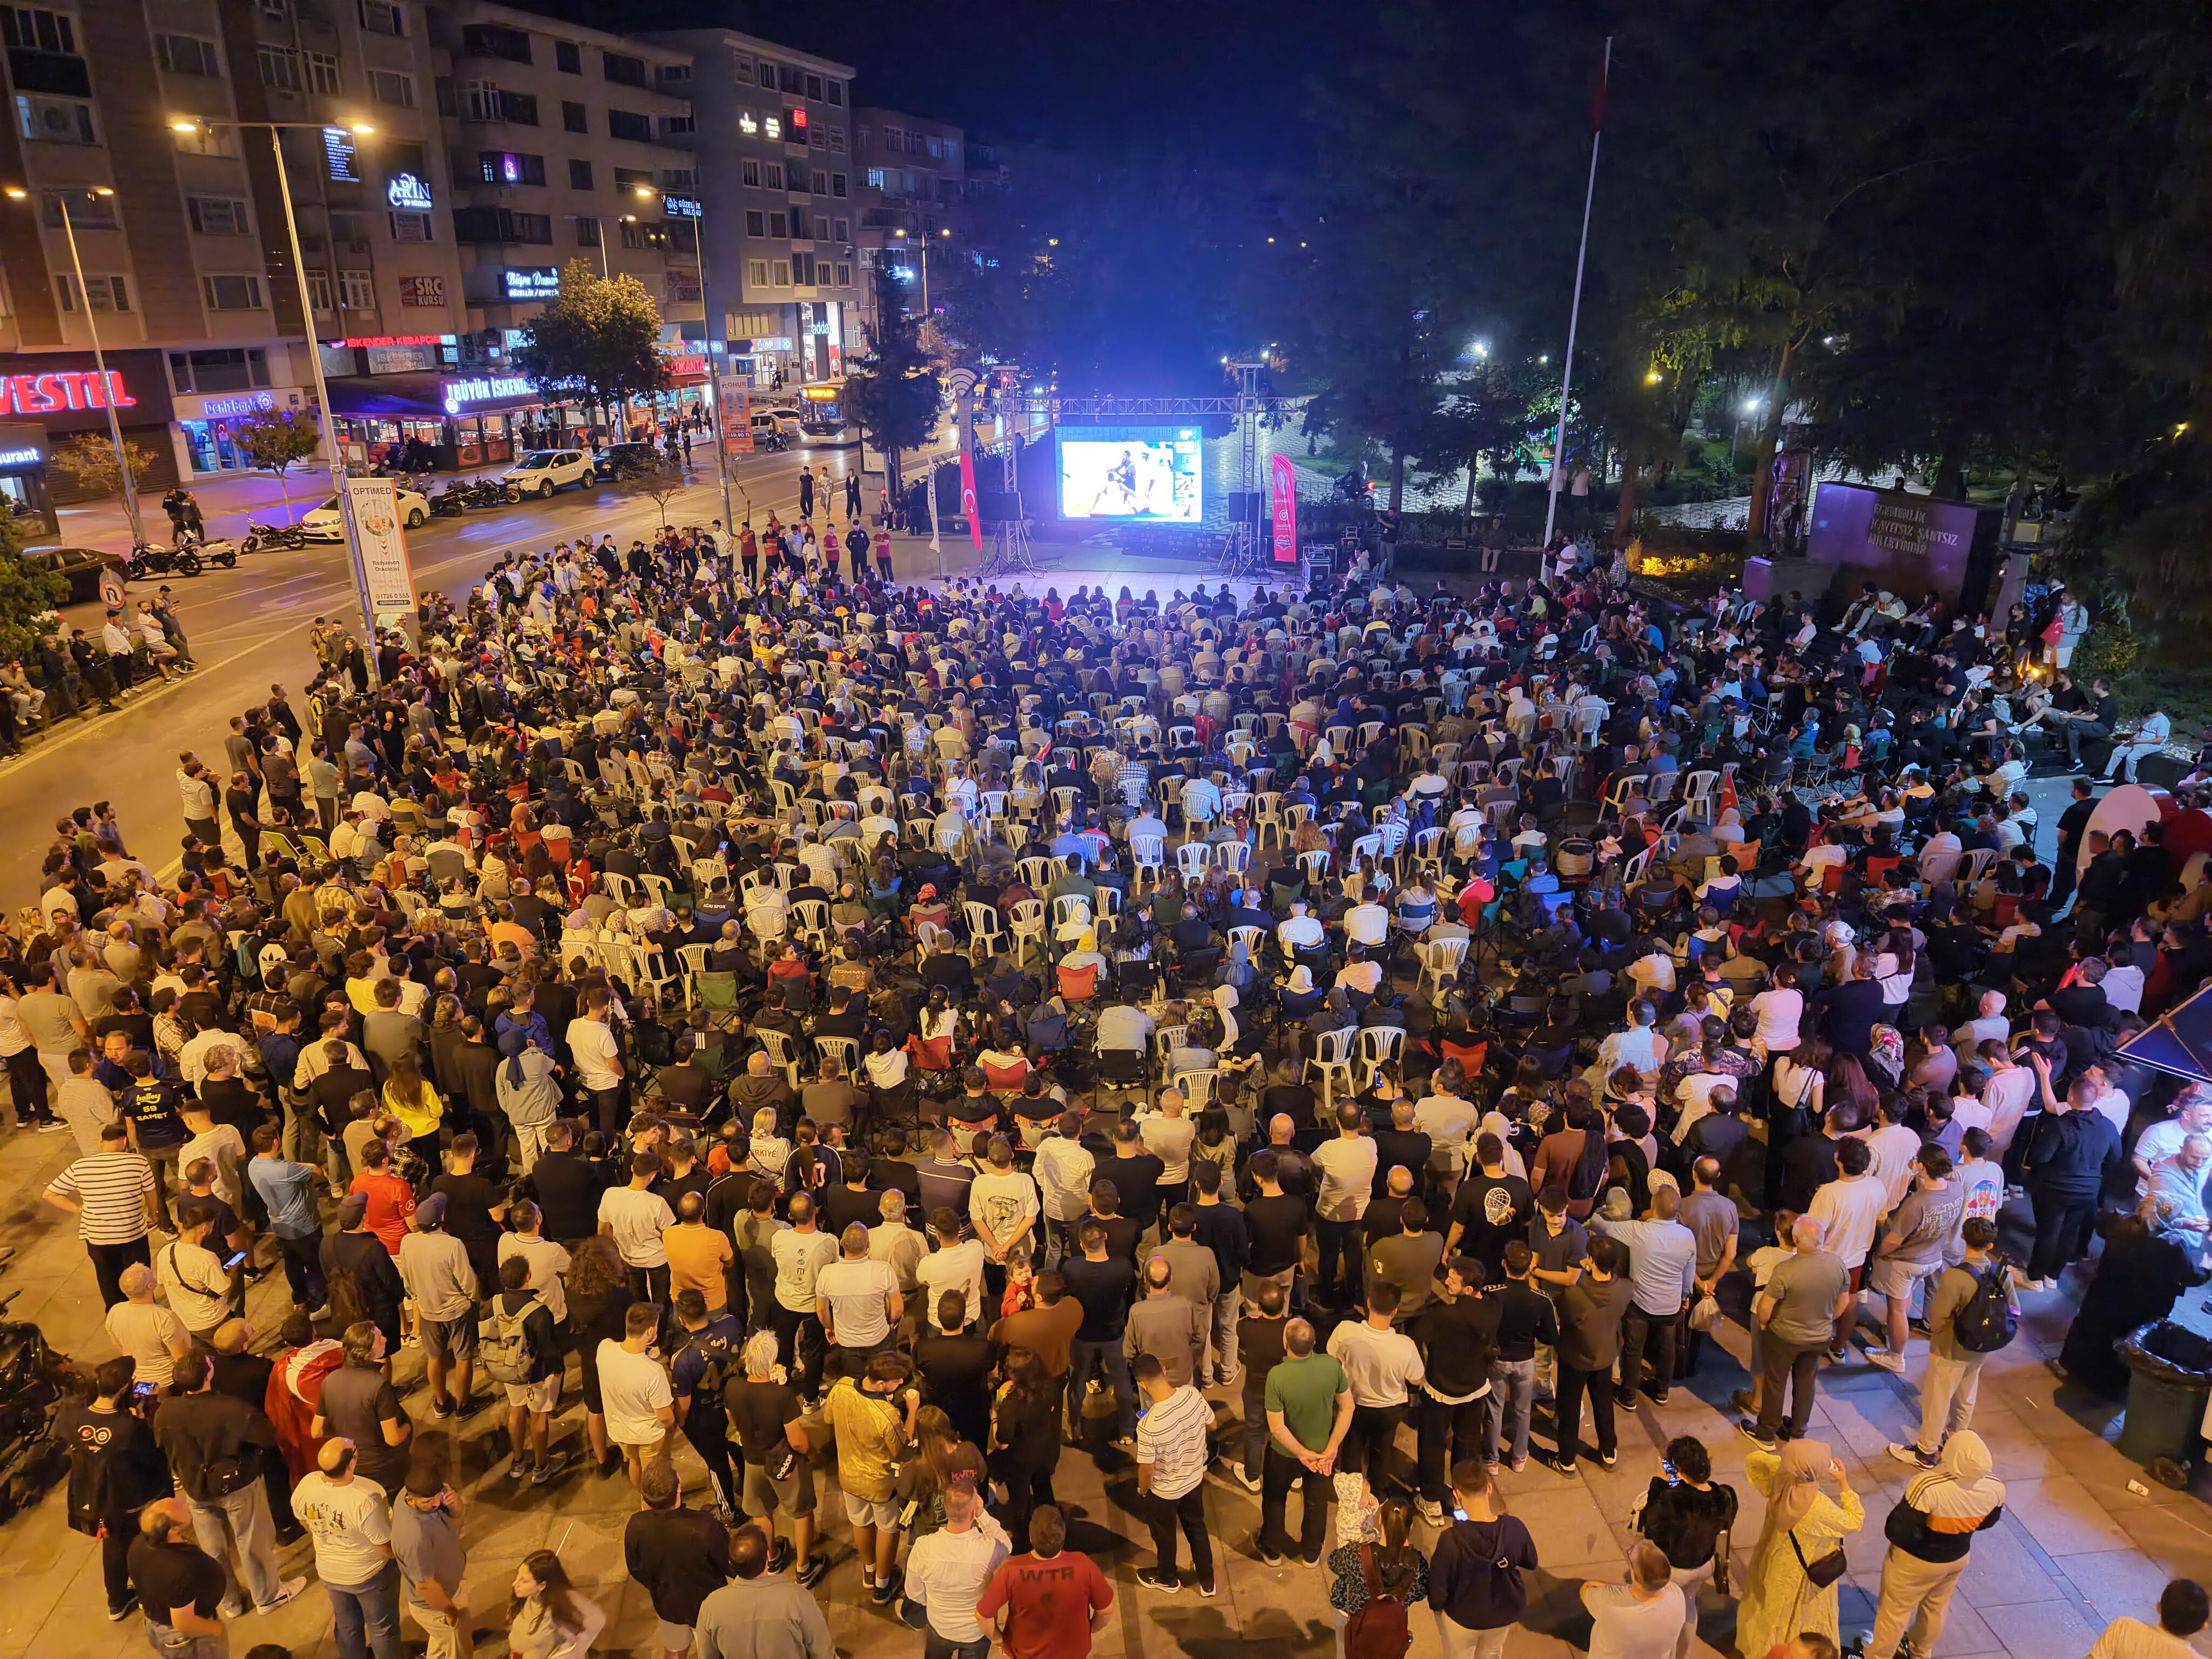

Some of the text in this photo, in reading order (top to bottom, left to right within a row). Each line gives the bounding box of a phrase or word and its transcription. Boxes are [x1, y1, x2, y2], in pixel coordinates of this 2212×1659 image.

[415, 277, 442, 295] SRC
[418, 295, 443, 306] KURSU
[453, 377, 489, 401] BÜYÜK
[1156, 427, 1172, 436] FIBA
[136, 1112, 168, 1122] SAMET
[777, 1454, 793, 1479] adidas
